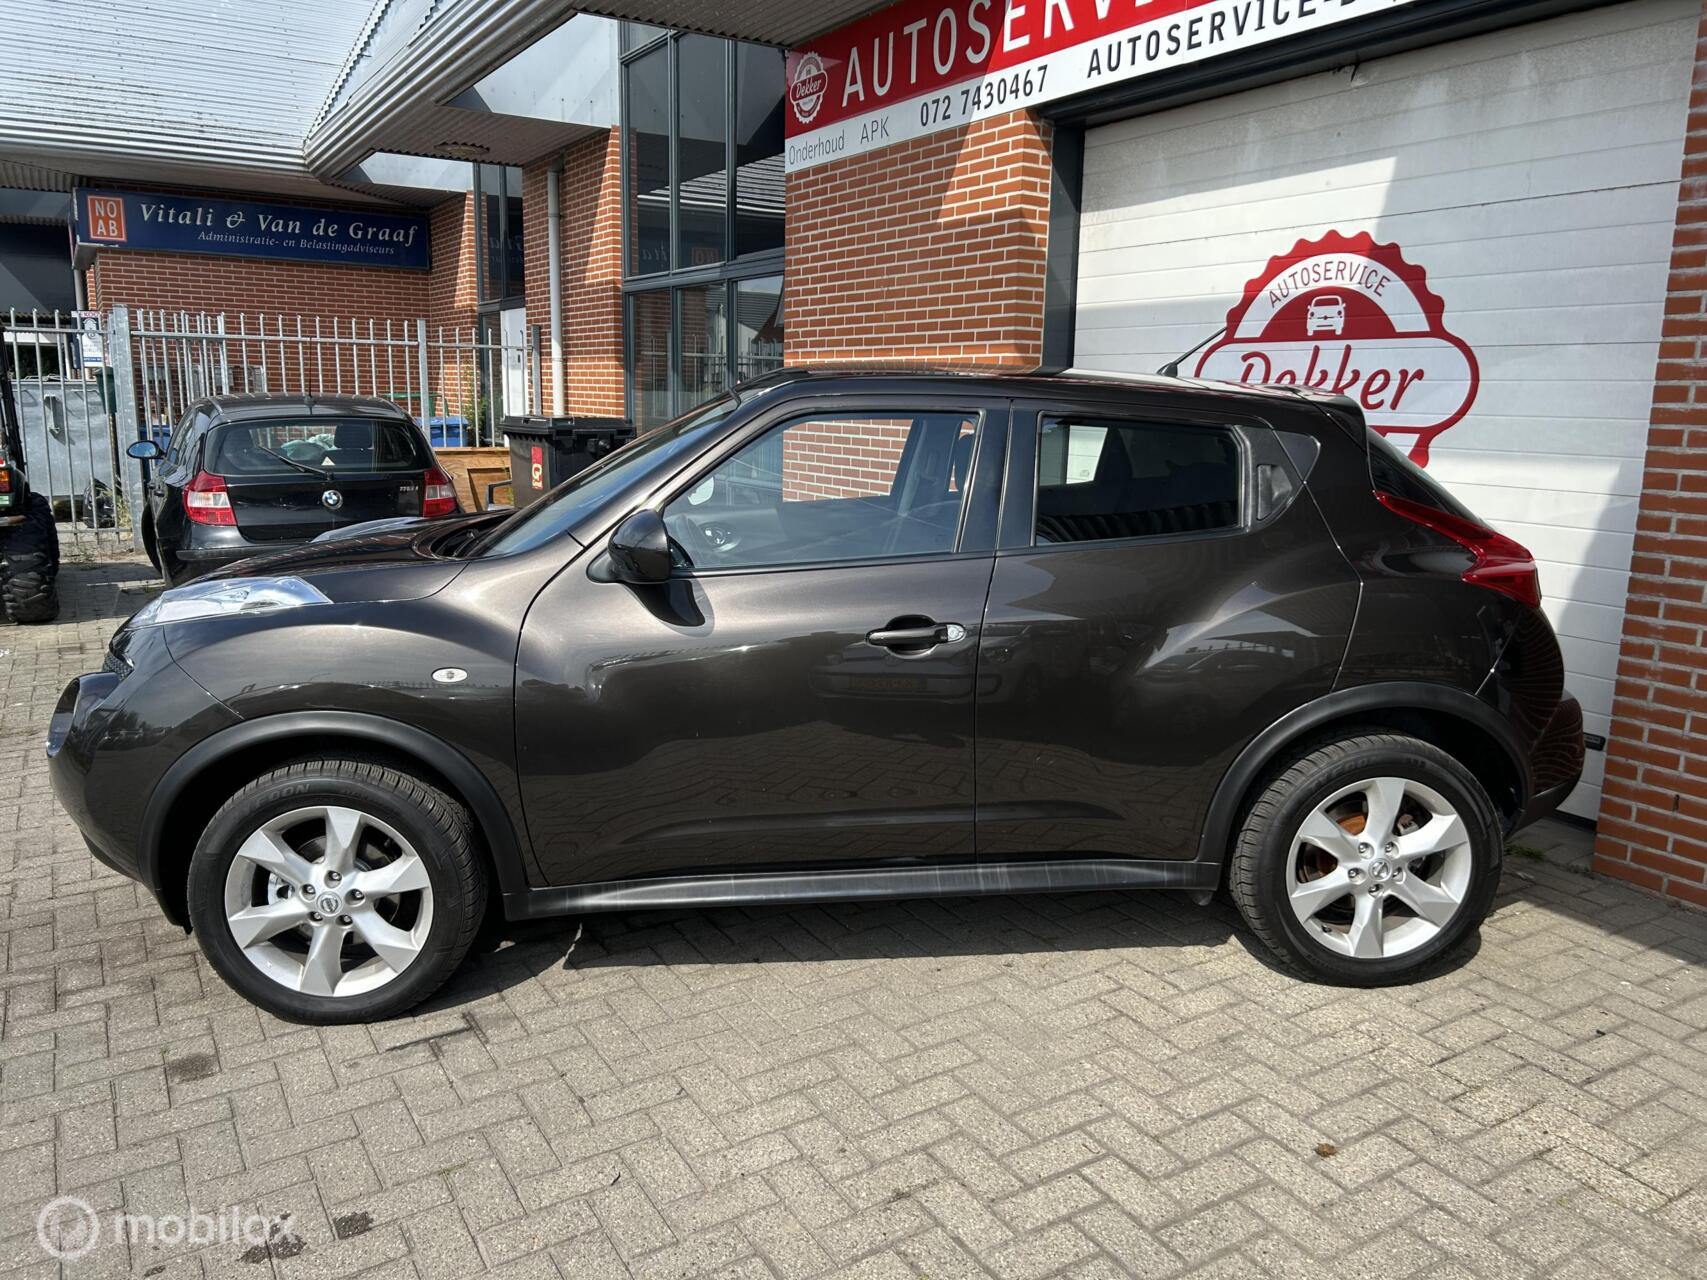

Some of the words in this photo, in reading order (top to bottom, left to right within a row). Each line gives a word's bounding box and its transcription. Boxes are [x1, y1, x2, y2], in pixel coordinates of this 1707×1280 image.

[796, 77, 821, 98] Dekker
[920, 95, 951, 127] 072
[960, 64, 1048, 116] 7430467
[788, 130, 845, 165] Onderhoud
[860, 115, 889, 145] APK
[95, 200, 117, 218] NO
[140, 203, 214, 226] Vitali
[225, 211, 245, 229] &
[258, 214, 301, 234] Van
[312, 218, 338, 237] de
[348, 222, 418, 247] Graaf
[97, 219, 118, 237] AB
[198, 230, 279, 246] Administratie-
[283, 238, 296, 247] en
[300, 238, 395, 255] Belastingadviseurs
[1269, 260, 1391, 309] AUTOSERVICE
